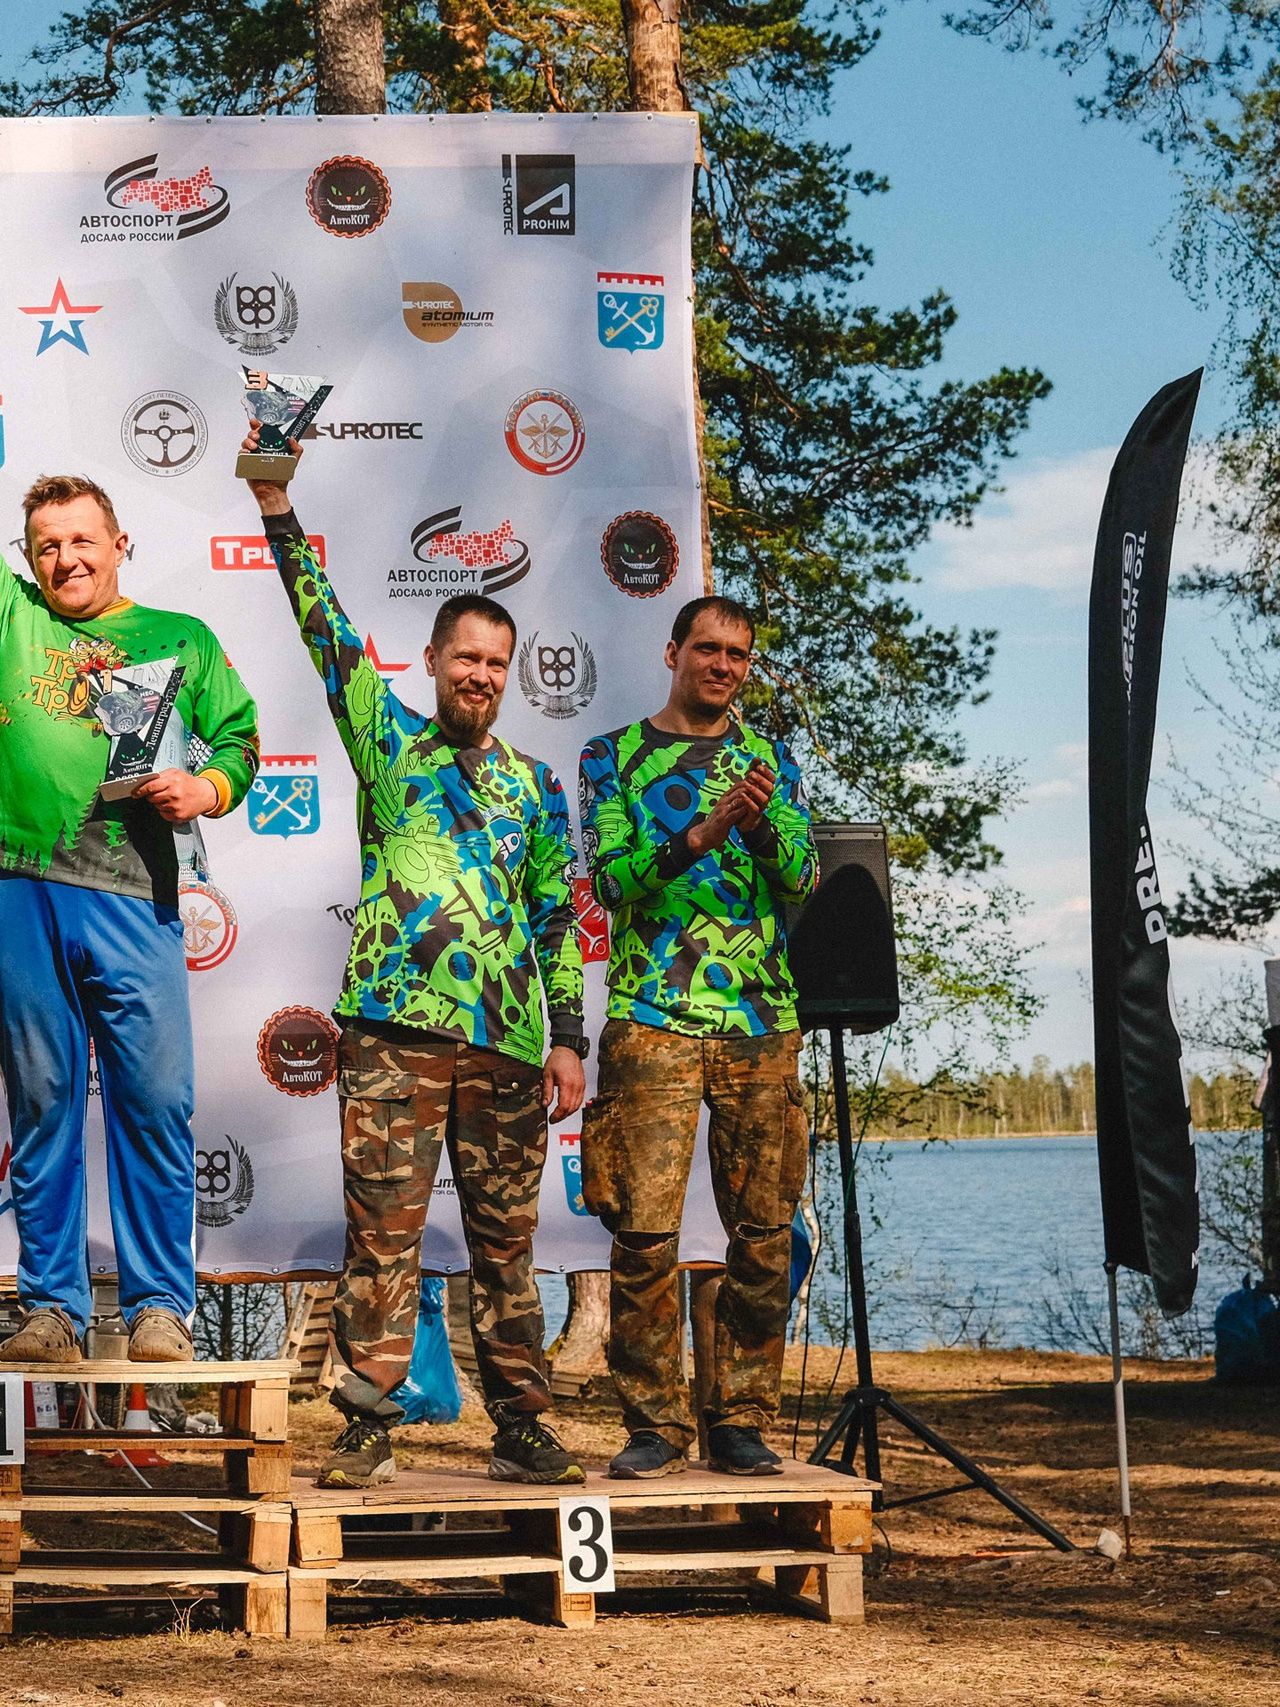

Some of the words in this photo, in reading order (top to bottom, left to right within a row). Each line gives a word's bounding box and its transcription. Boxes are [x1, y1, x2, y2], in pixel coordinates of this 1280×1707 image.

[503, 177, 514, 236] SUPROTEC
[79, 214, 174, 228] АВТОСПОРТ
[522, 219, 570, 230] PROHIM
[80, 233, 126, 244] ДОСААФ
[129, 232, 174, 242] РОССИИ
[412, 300, 455, 309] SUPROTEC
[421, 310, 494, 321] atomium
[319, 422, 424, 440] SUPROTEC
[387, 569, 478, 583] АВТОСПОРТ
[388, 588, 433, 599] ДОСААФ
[435, 587, 479, 598] РОССИИ
[100, 670, 113, 693] 1
[568, 1506, 608, 1583] 3
